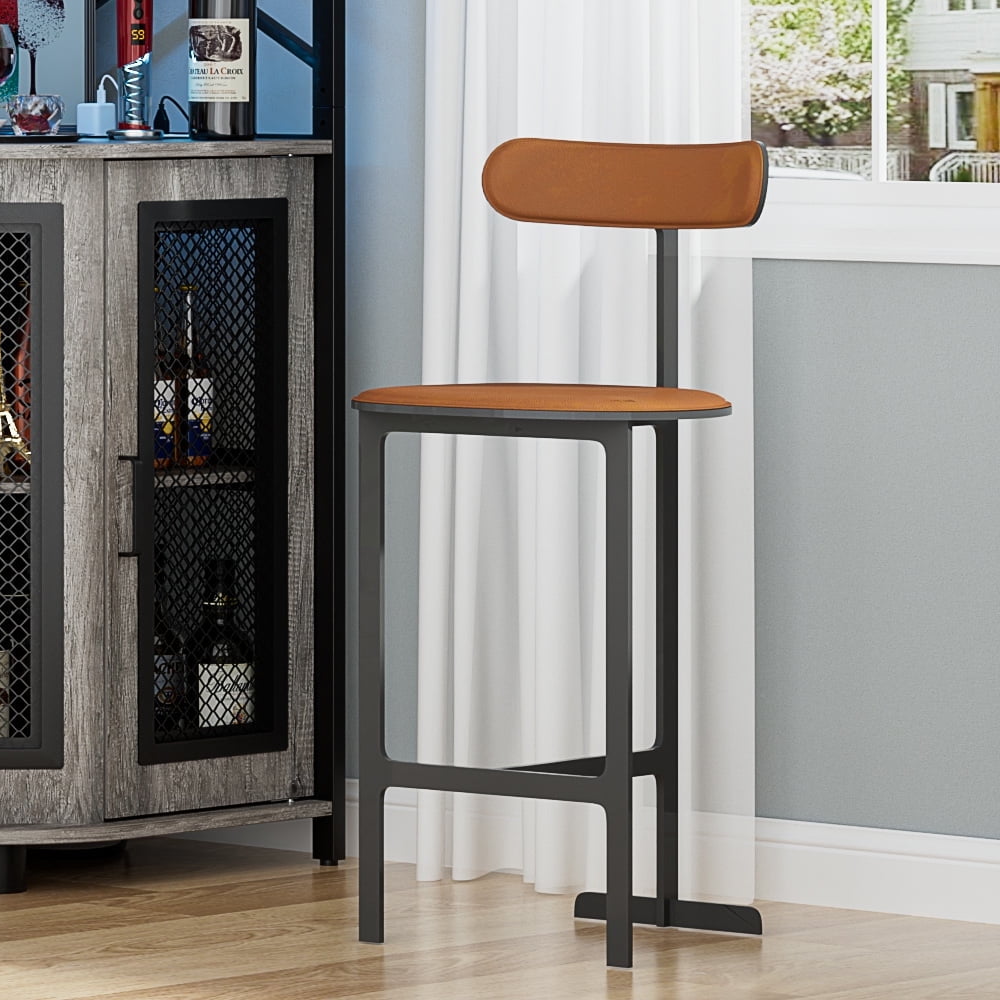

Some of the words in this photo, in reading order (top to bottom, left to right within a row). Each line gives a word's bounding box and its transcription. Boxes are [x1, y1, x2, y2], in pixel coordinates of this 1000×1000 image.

[131, 29, 145, 40] 59
[210, 67, 219, 75] LA
[220, 67, 243, 75] CROIX
